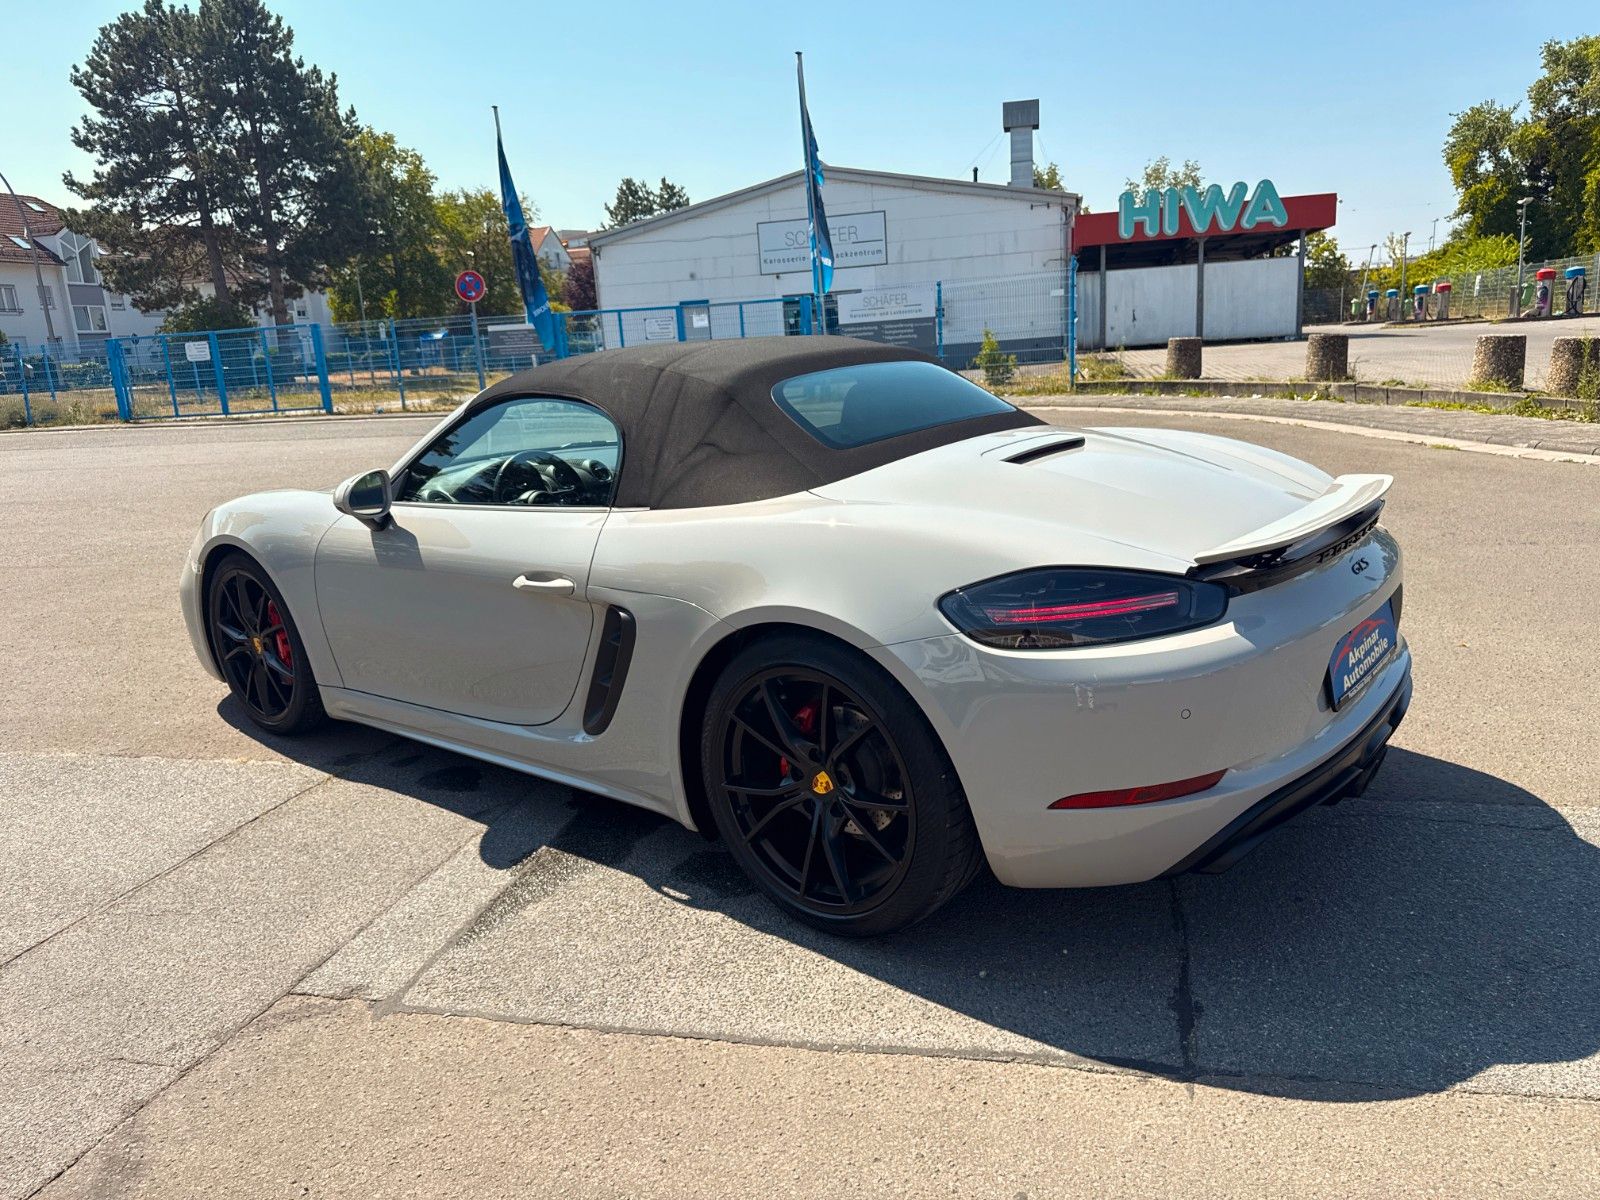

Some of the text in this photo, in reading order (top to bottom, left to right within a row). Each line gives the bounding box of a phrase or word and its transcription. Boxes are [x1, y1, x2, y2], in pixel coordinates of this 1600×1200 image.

[1119, 179, 1288, 239] HIWA
[784, 225, 859, 247] SCFER
[835, 248, 883, 259] ackzentrum
[863, 293, 908, 307] SCHÄFER
[1348, 628, 1379, 668] Akpinar
[1343, 637, 1388, 692] Automobile
